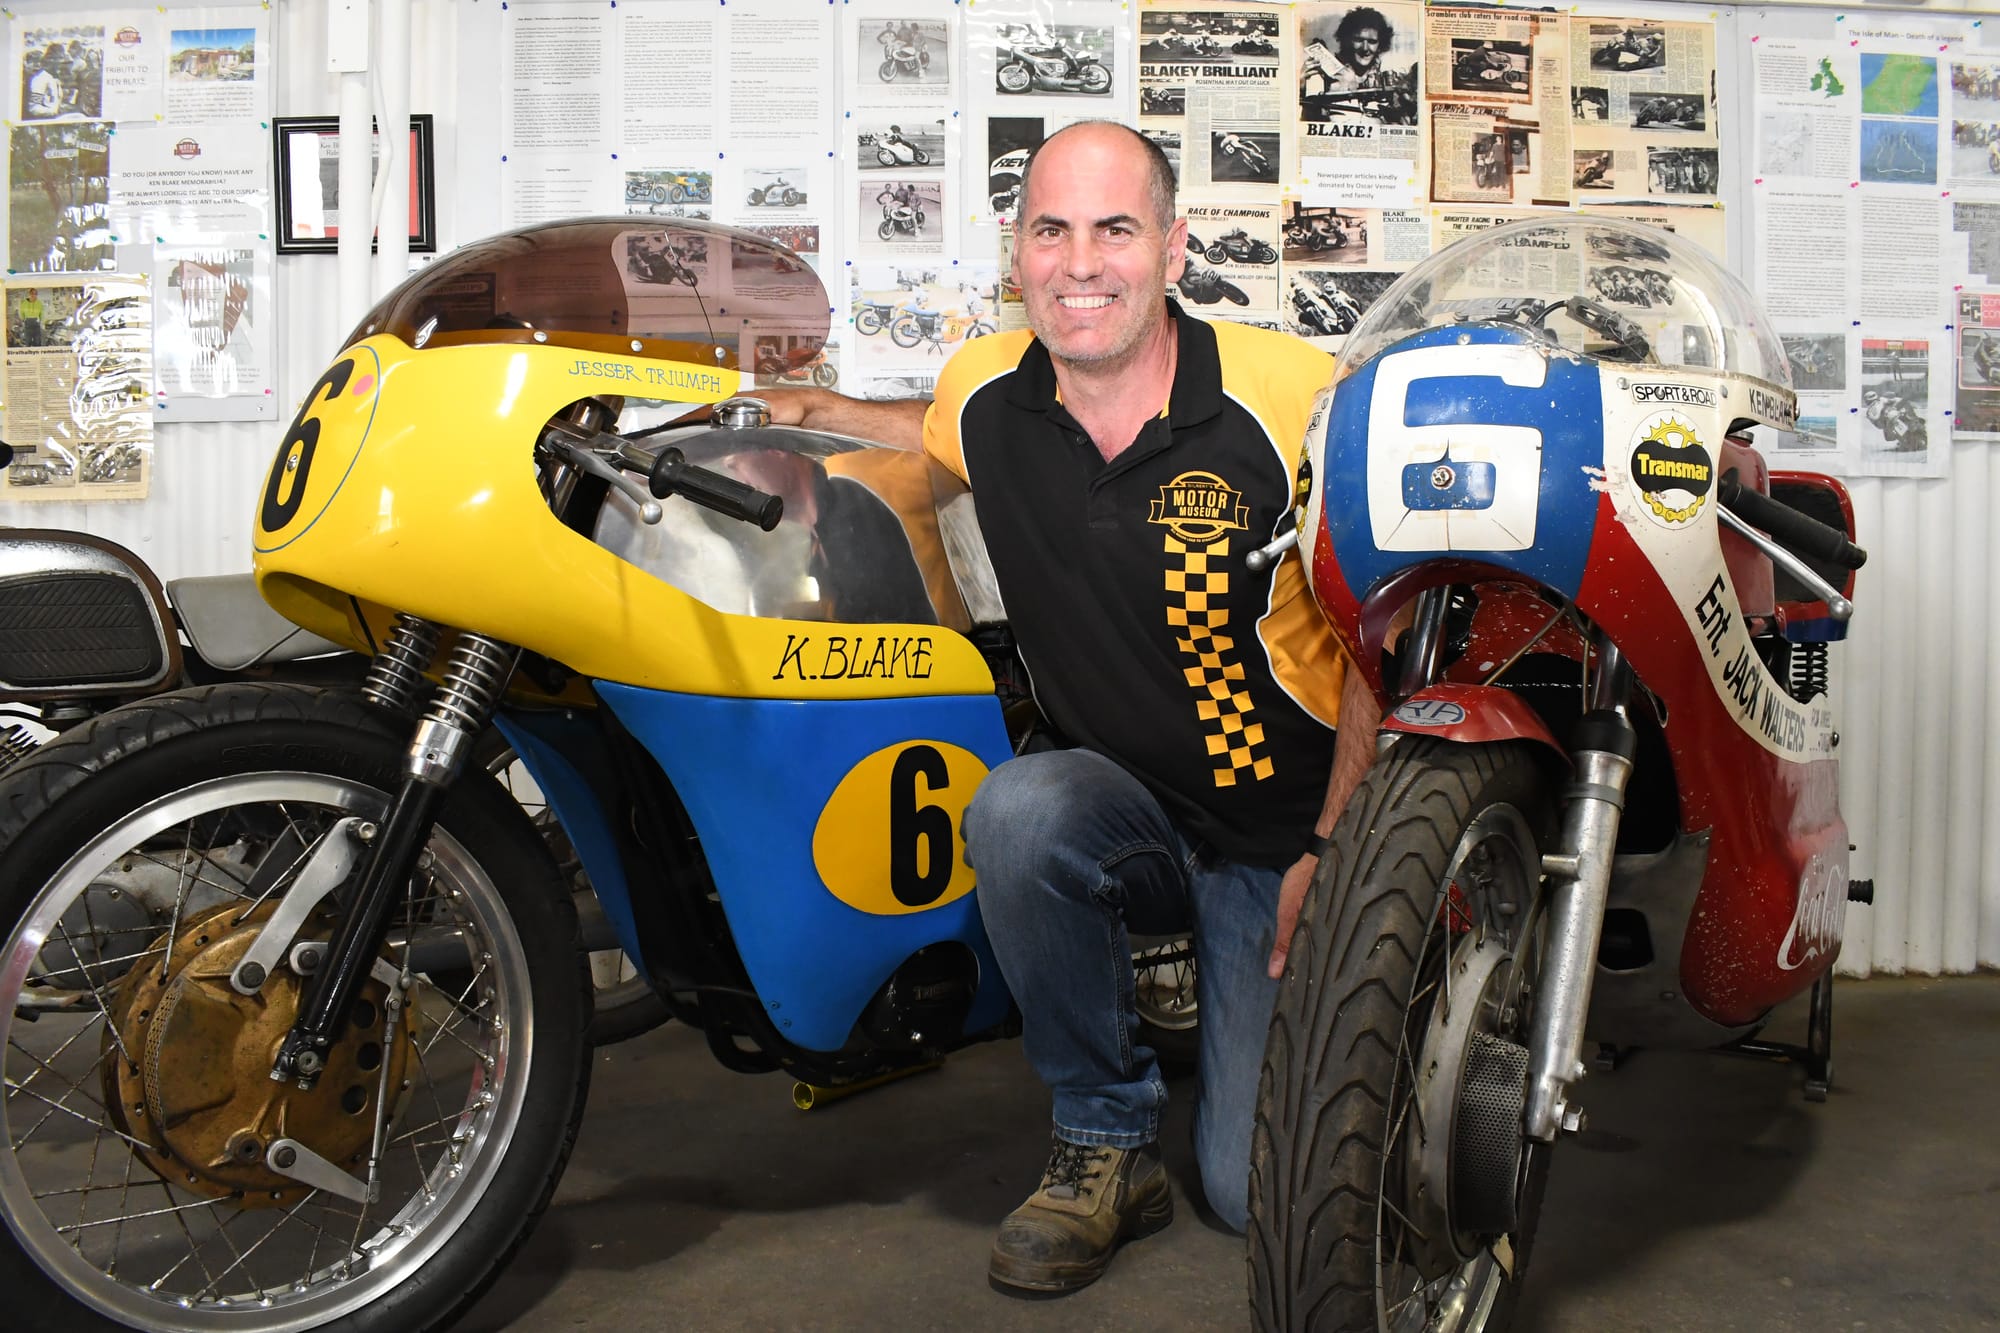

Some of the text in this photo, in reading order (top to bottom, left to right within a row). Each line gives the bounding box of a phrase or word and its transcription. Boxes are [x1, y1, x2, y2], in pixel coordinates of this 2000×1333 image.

[1426, 9, 1456, 18] Scrambles
[1459, 10, 1472, 18] club
[1474, 12, 1491, 20] caters
[1494, 12, 1502, 20] for
[1505, 13, 1519, 21] road
[138, 65, 148, 73] TO
[1140, 65, 1279, 78] BLAKEY BRILLIANT
[106, 78, 121, 86] KEN
[1433, 104, 1469, 114] ORIENTAL
[1306, 123, 1373, 139] BLAKE!
[1317, 172, 1398, 181] Newspaper articles kindly
[1355, 182, 1373, 190] Oscar
[1354, 192, 1374, 200] family
[1188, 207, 1270, 218] RACE OF CHAMPIONS
[568, 360, 721, 394] JESSER TRIUMPH
[261, 358, 355, 533] 6
[1367, 343, 1548, 552] 6
[1637, 453, 1710, 481] Transmar
[1173, 489, 1228, 509] MOTOR
[1179, 506, 1220, 518] MUSEUM
[1694, 573, 1806, 753] Ent. JACK WALTERS
[891, 745, 953, 907] 6
